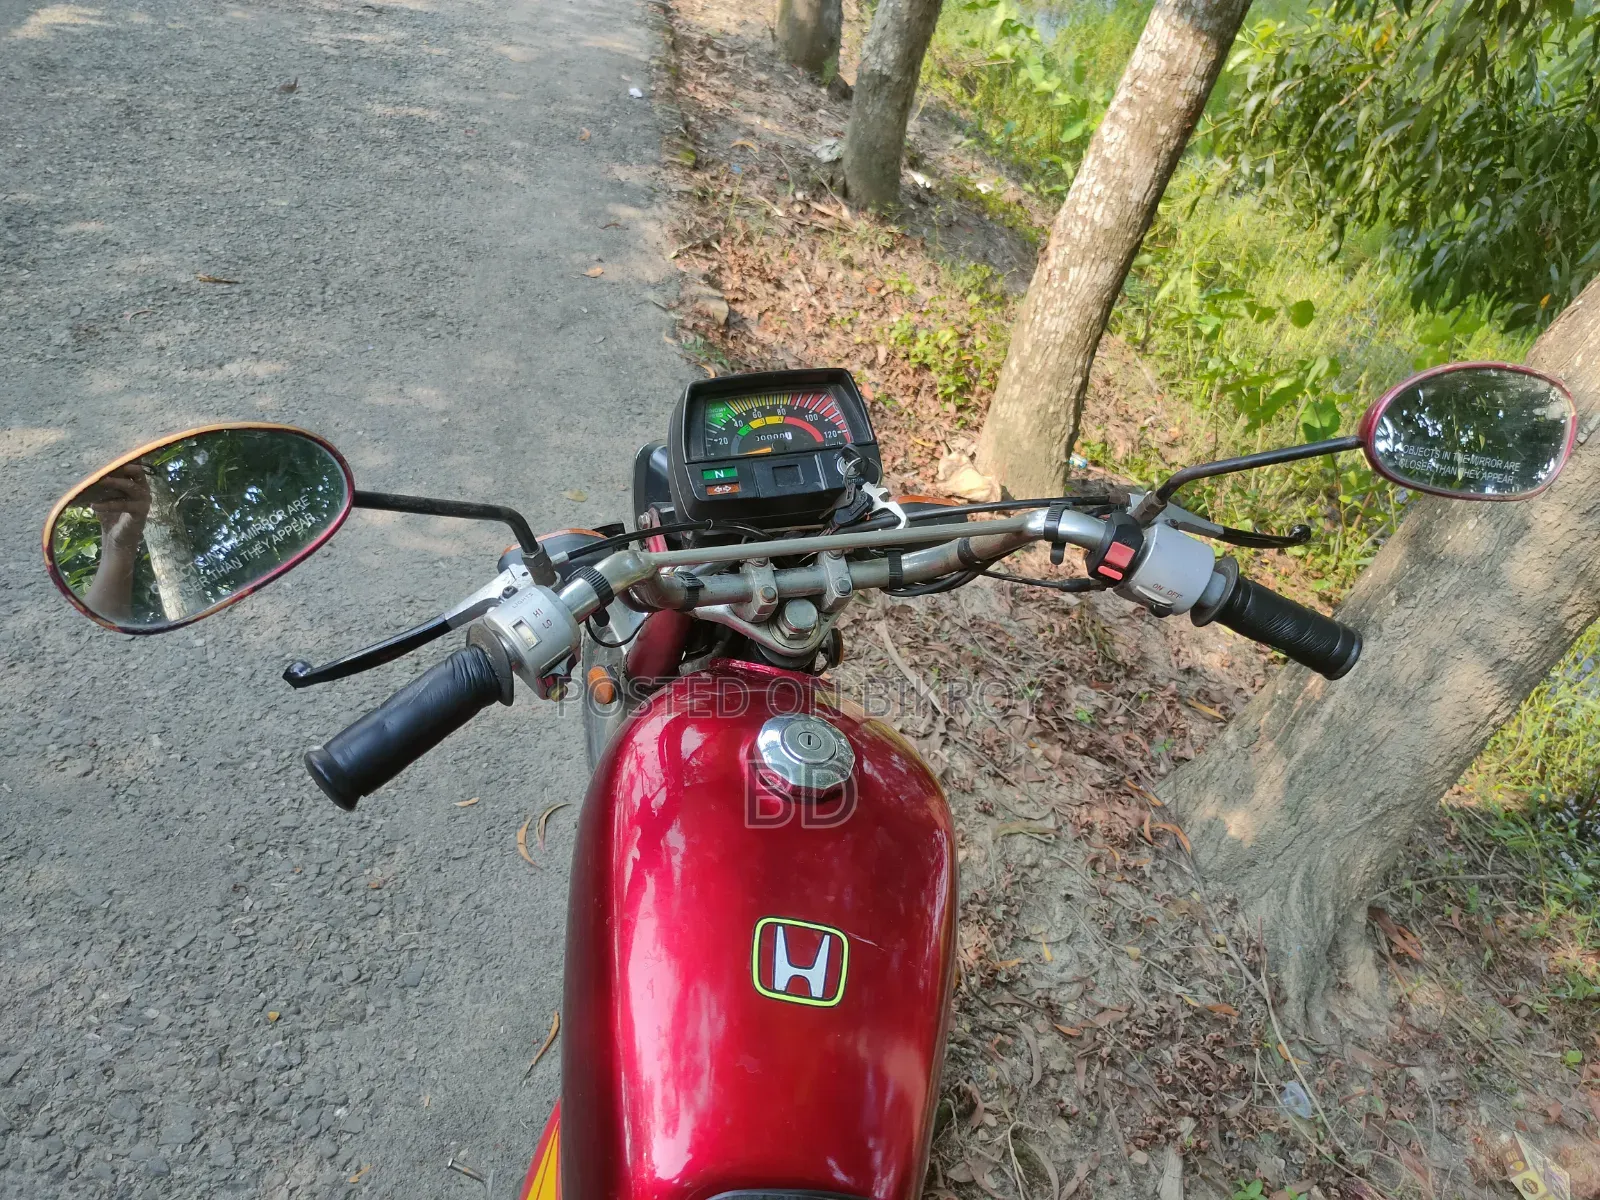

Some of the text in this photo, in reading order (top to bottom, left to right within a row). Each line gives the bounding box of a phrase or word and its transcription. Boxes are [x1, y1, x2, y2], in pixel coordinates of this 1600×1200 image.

[752, 411, 762, 419] 60
[777, 408, 786, 416] 80
[805, 413, 818, 422] 100
[733, 420, 743, 428] 40
[824, 430, 837, 438] 120
[719, 437, 728, 445] 20
[1402, 445, 1521, 472] OBJECTS IN THE MIRROR ARE
[714, 470, 724, 478] N
[1399, 458, 1433, 471] CLOSER
[1434, 463, 1457, 476] THAN
[1480, 472, 1514, 484] APPEAR
[244, 509, 288, 543] MIRROR
[288, 495, 311, 516] ARE
[209, 557, 243, 581] THAN
[240, 538, 270, 562] THEY
[271, 512, 314, 544] APPEAR
[1152, 583, 1183, 599] ON OFF
[512, 592, 534, 609] LIGHTS
[533, 608, 543, 618] HI
[542, 619, 553, 629] LO
